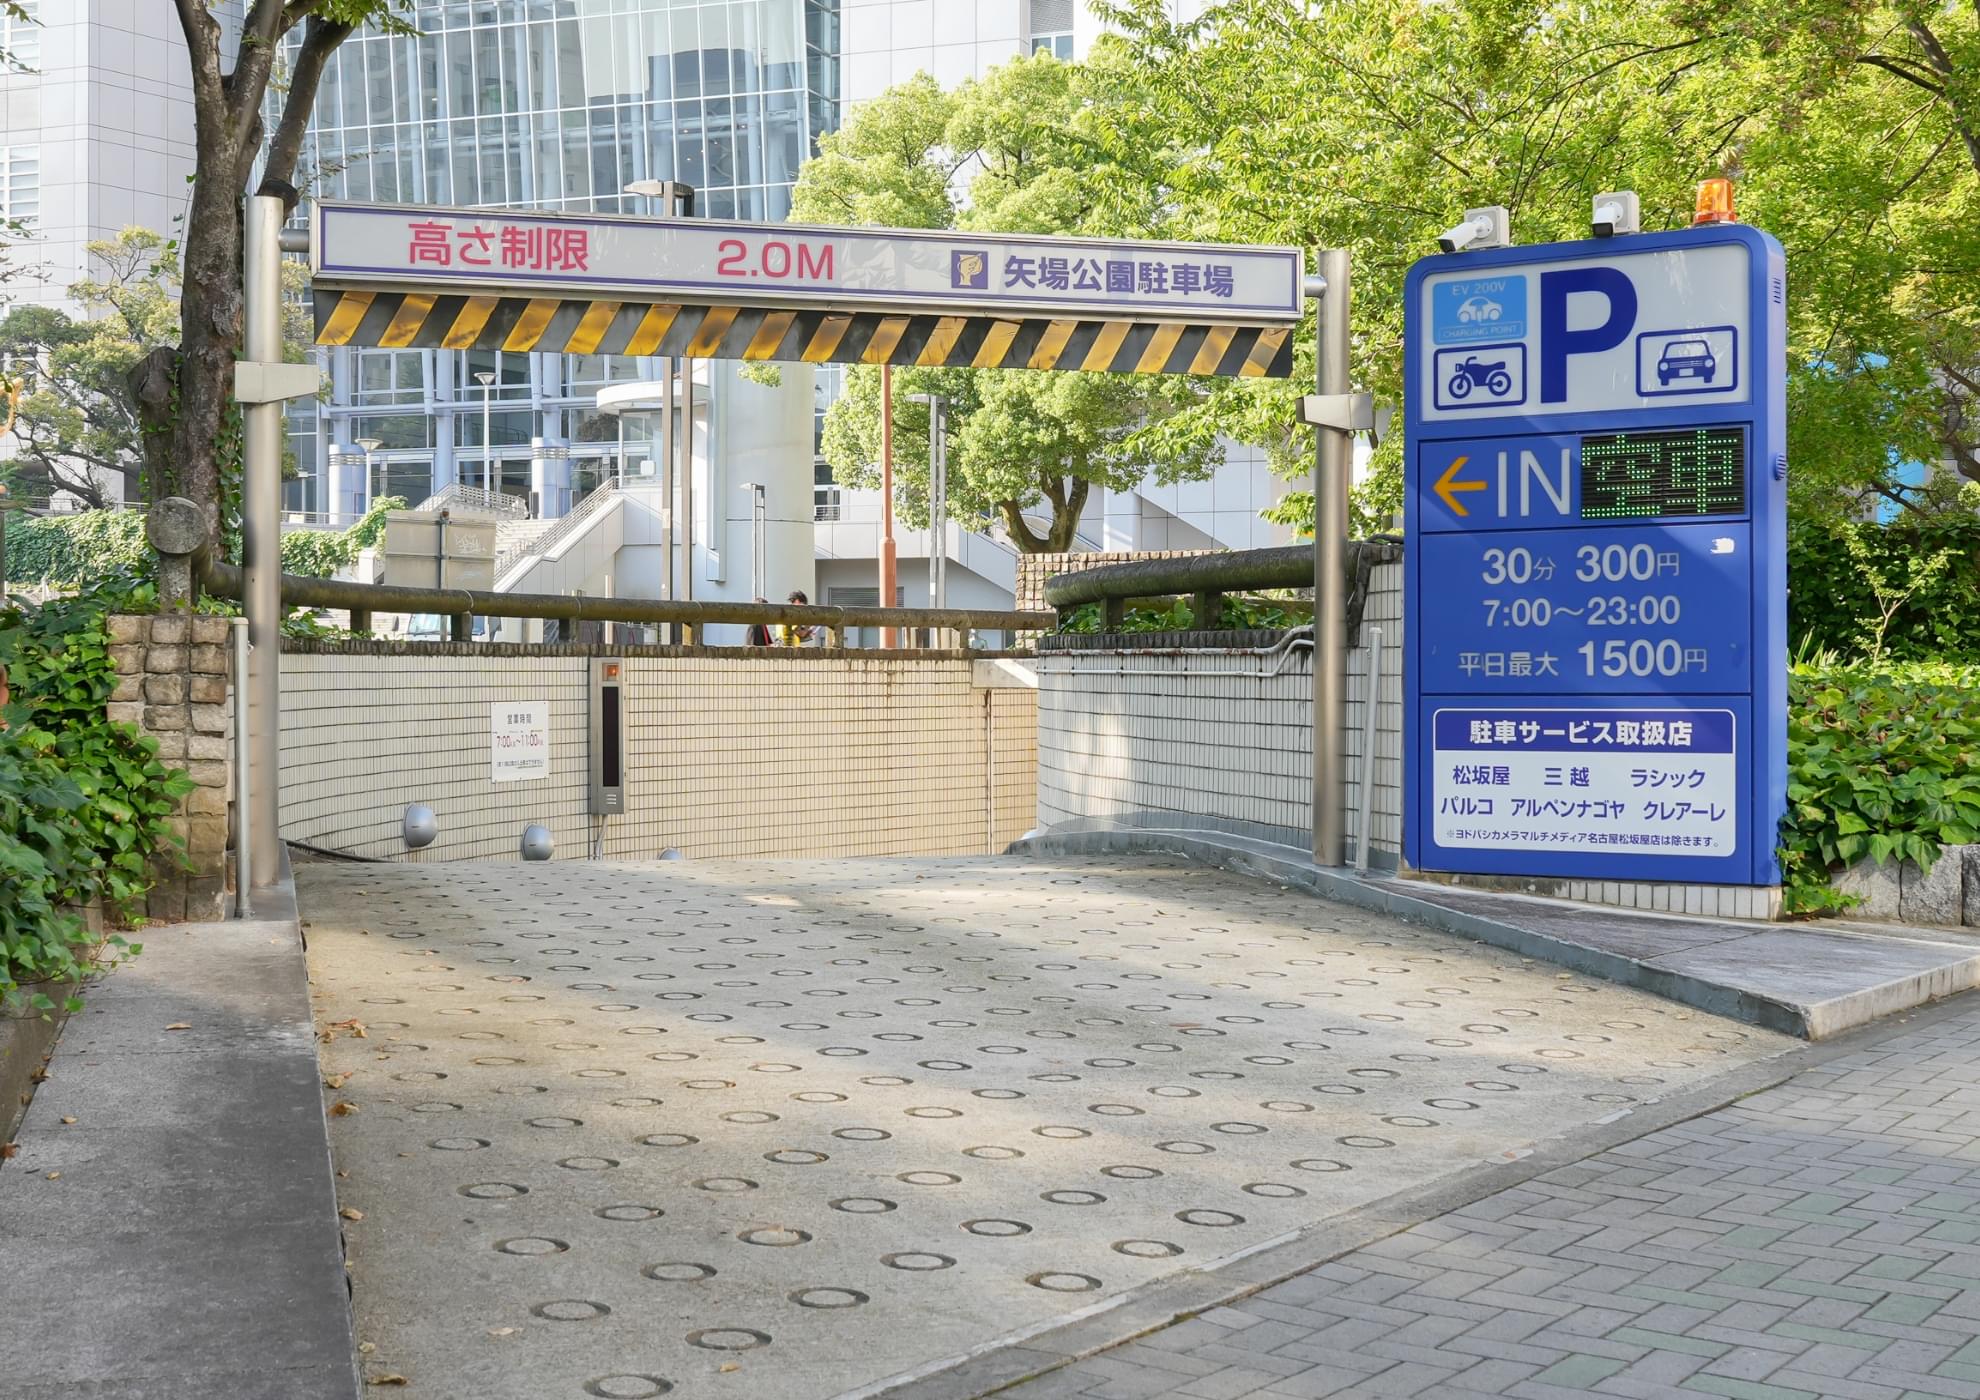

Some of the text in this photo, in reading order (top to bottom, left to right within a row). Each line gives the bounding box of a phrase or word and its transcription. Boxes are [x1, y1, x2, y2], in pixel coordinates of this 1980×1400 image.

[407, 221, 835, 280] 高さ制限 2.0M
[1004, 255, 1234, 298] 矢場公園駐車場
[1452, 280, 1506, 296] EV 200V
[1443, 325, 1517, 337] CHARGING POINT
[1540, 267, 1638, 404] P
[1497, 449, 1571, 518] IN
[1581, 430, 1738, 518] 空車
[1482, 543, 1681, 585] 30分 300円
[1458, 639, 1708, 678] 平日最大 1500円
[1470, 720, 1693, 747] 駐車サービス取扱店
[1452, 765, 1511, 786] 松坂屋
[1630, 768, 1706, 789] ラシック
[1440, 797, 1726, 822] パルコ アルペンナゴヤ クレアーレ
